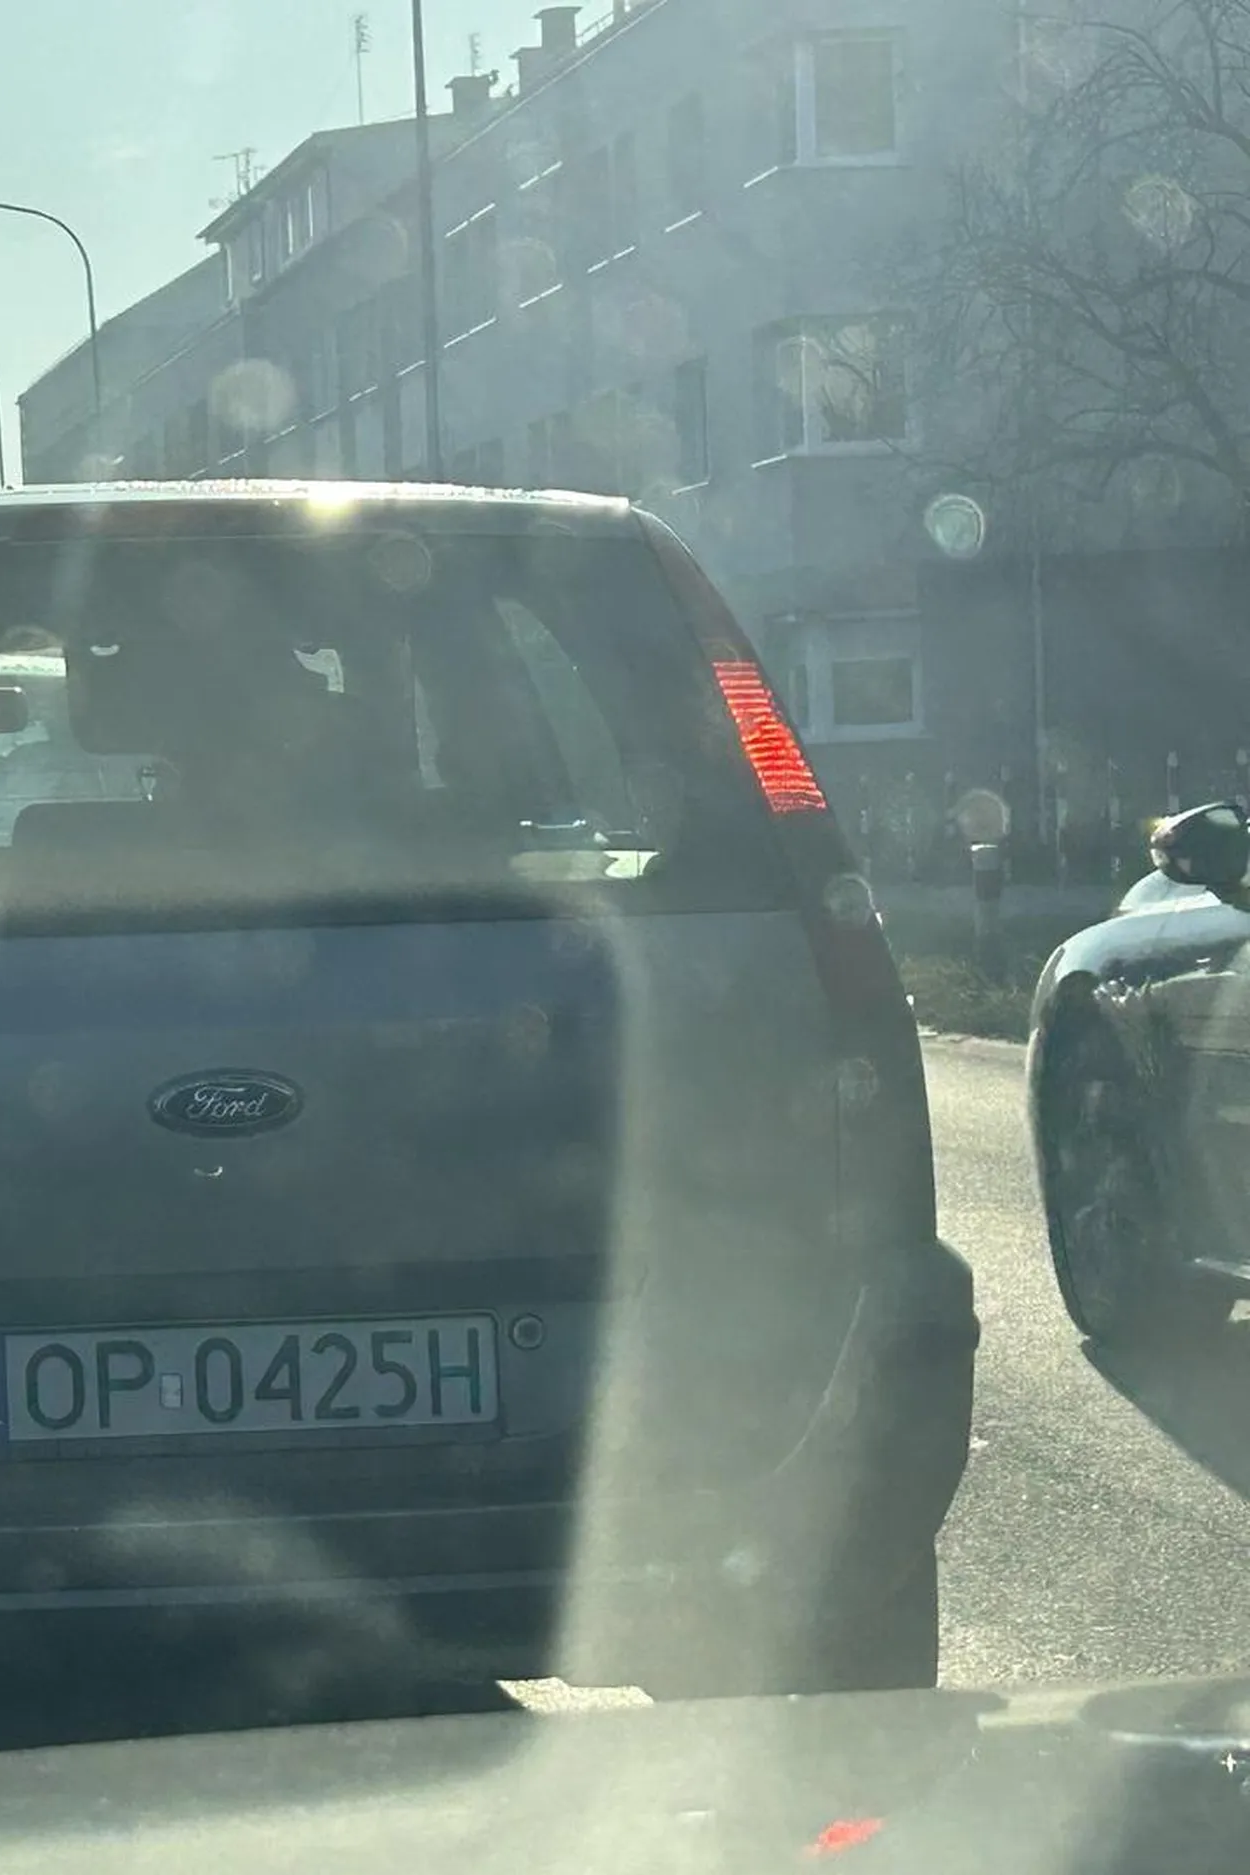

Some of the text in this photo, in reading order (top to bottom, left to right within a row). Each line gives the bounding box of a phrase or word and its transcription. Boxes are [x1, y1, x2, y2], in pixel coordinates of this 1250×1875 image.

[185, 1086, 268, 1118] Ford
[25, 1327, 482, 1430] OP 0425H
